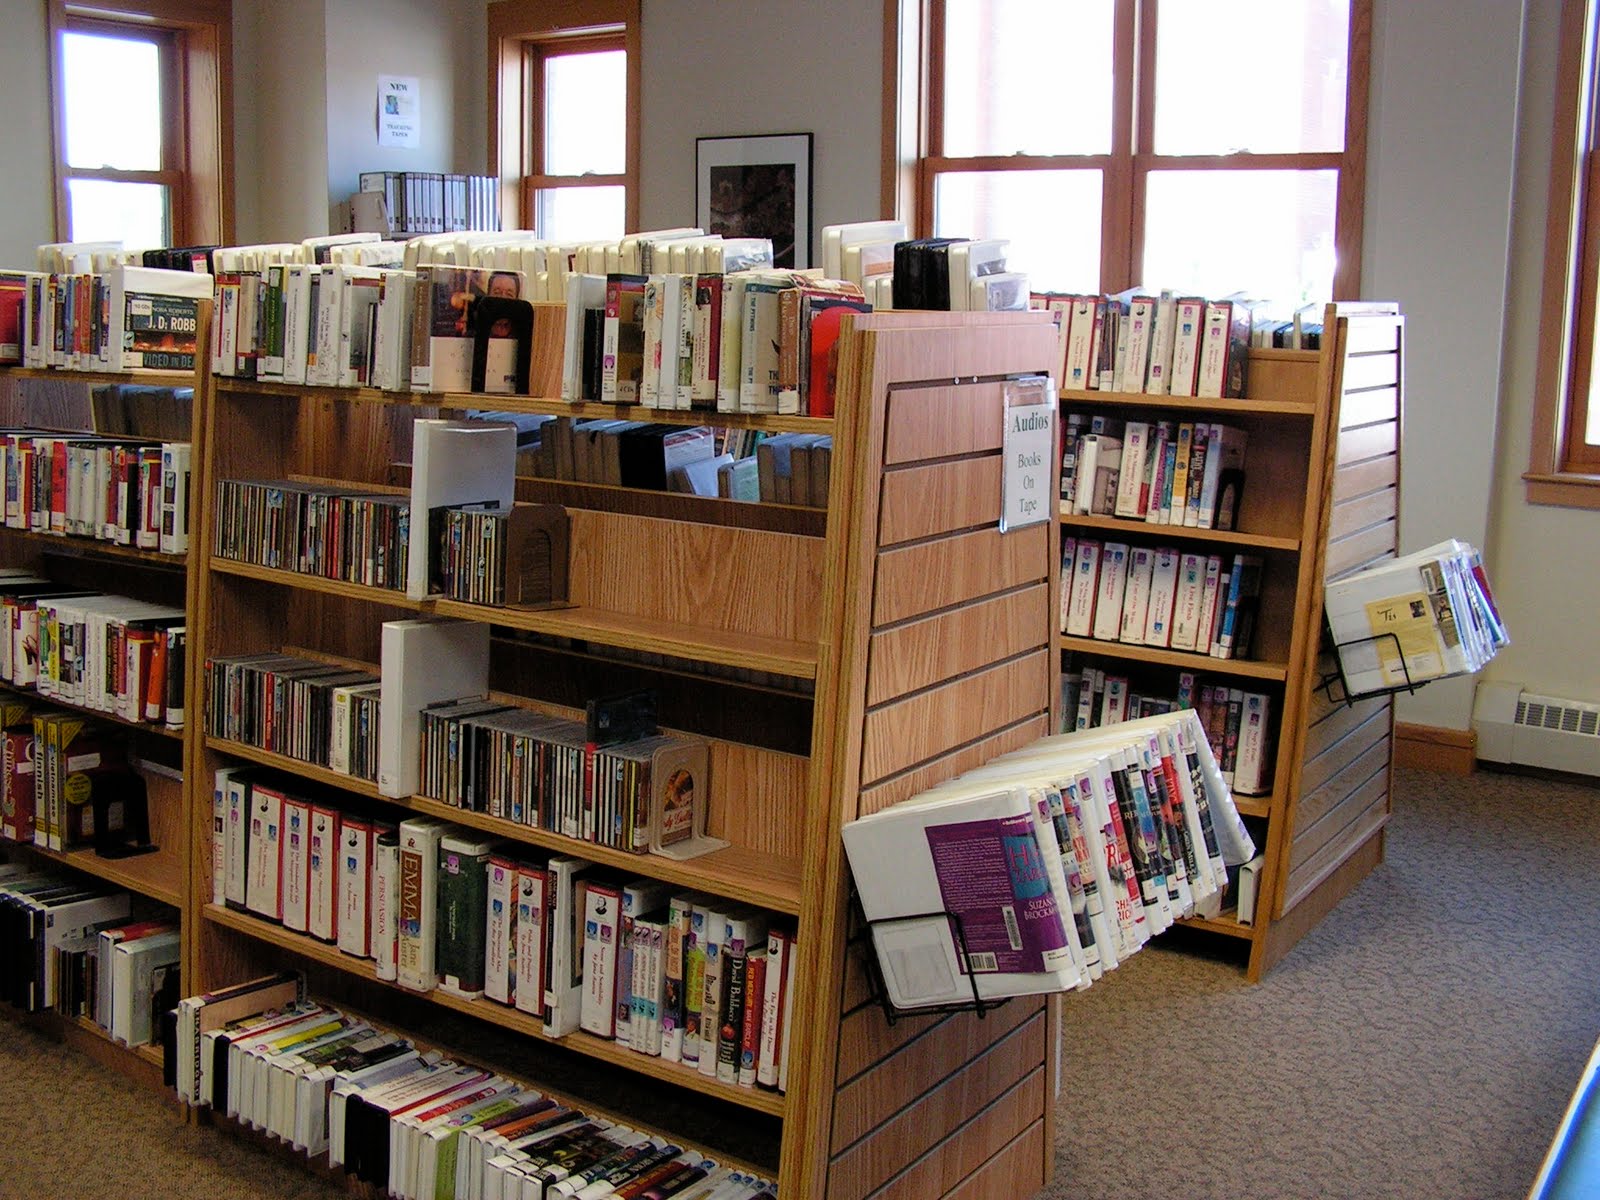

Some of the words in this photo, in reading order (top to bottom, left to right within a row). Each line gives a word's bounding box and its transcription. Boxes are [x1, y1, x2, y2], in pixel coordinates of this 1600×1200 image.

[390, 82, 408, 91] NEW
[170, 317, 196, 331] ROBB
[1012, 412, 1049, 433] Audios
[1018, 454, 1041, 468] Books
[1023, 475, 1034, 489] On
[1019, 498, 1037, 516] Tape
[5, 738, 16, 796] Chinese
[36, 752, 44, 800] finnish
[402, 856, 418, 921] EMMA
[378, 876, 386, 934] PERSUASION
[409, 944, 420, 966] Jane
[731, 960, 742, 984] David
[728, 987, 740, 1022] Baldacci
